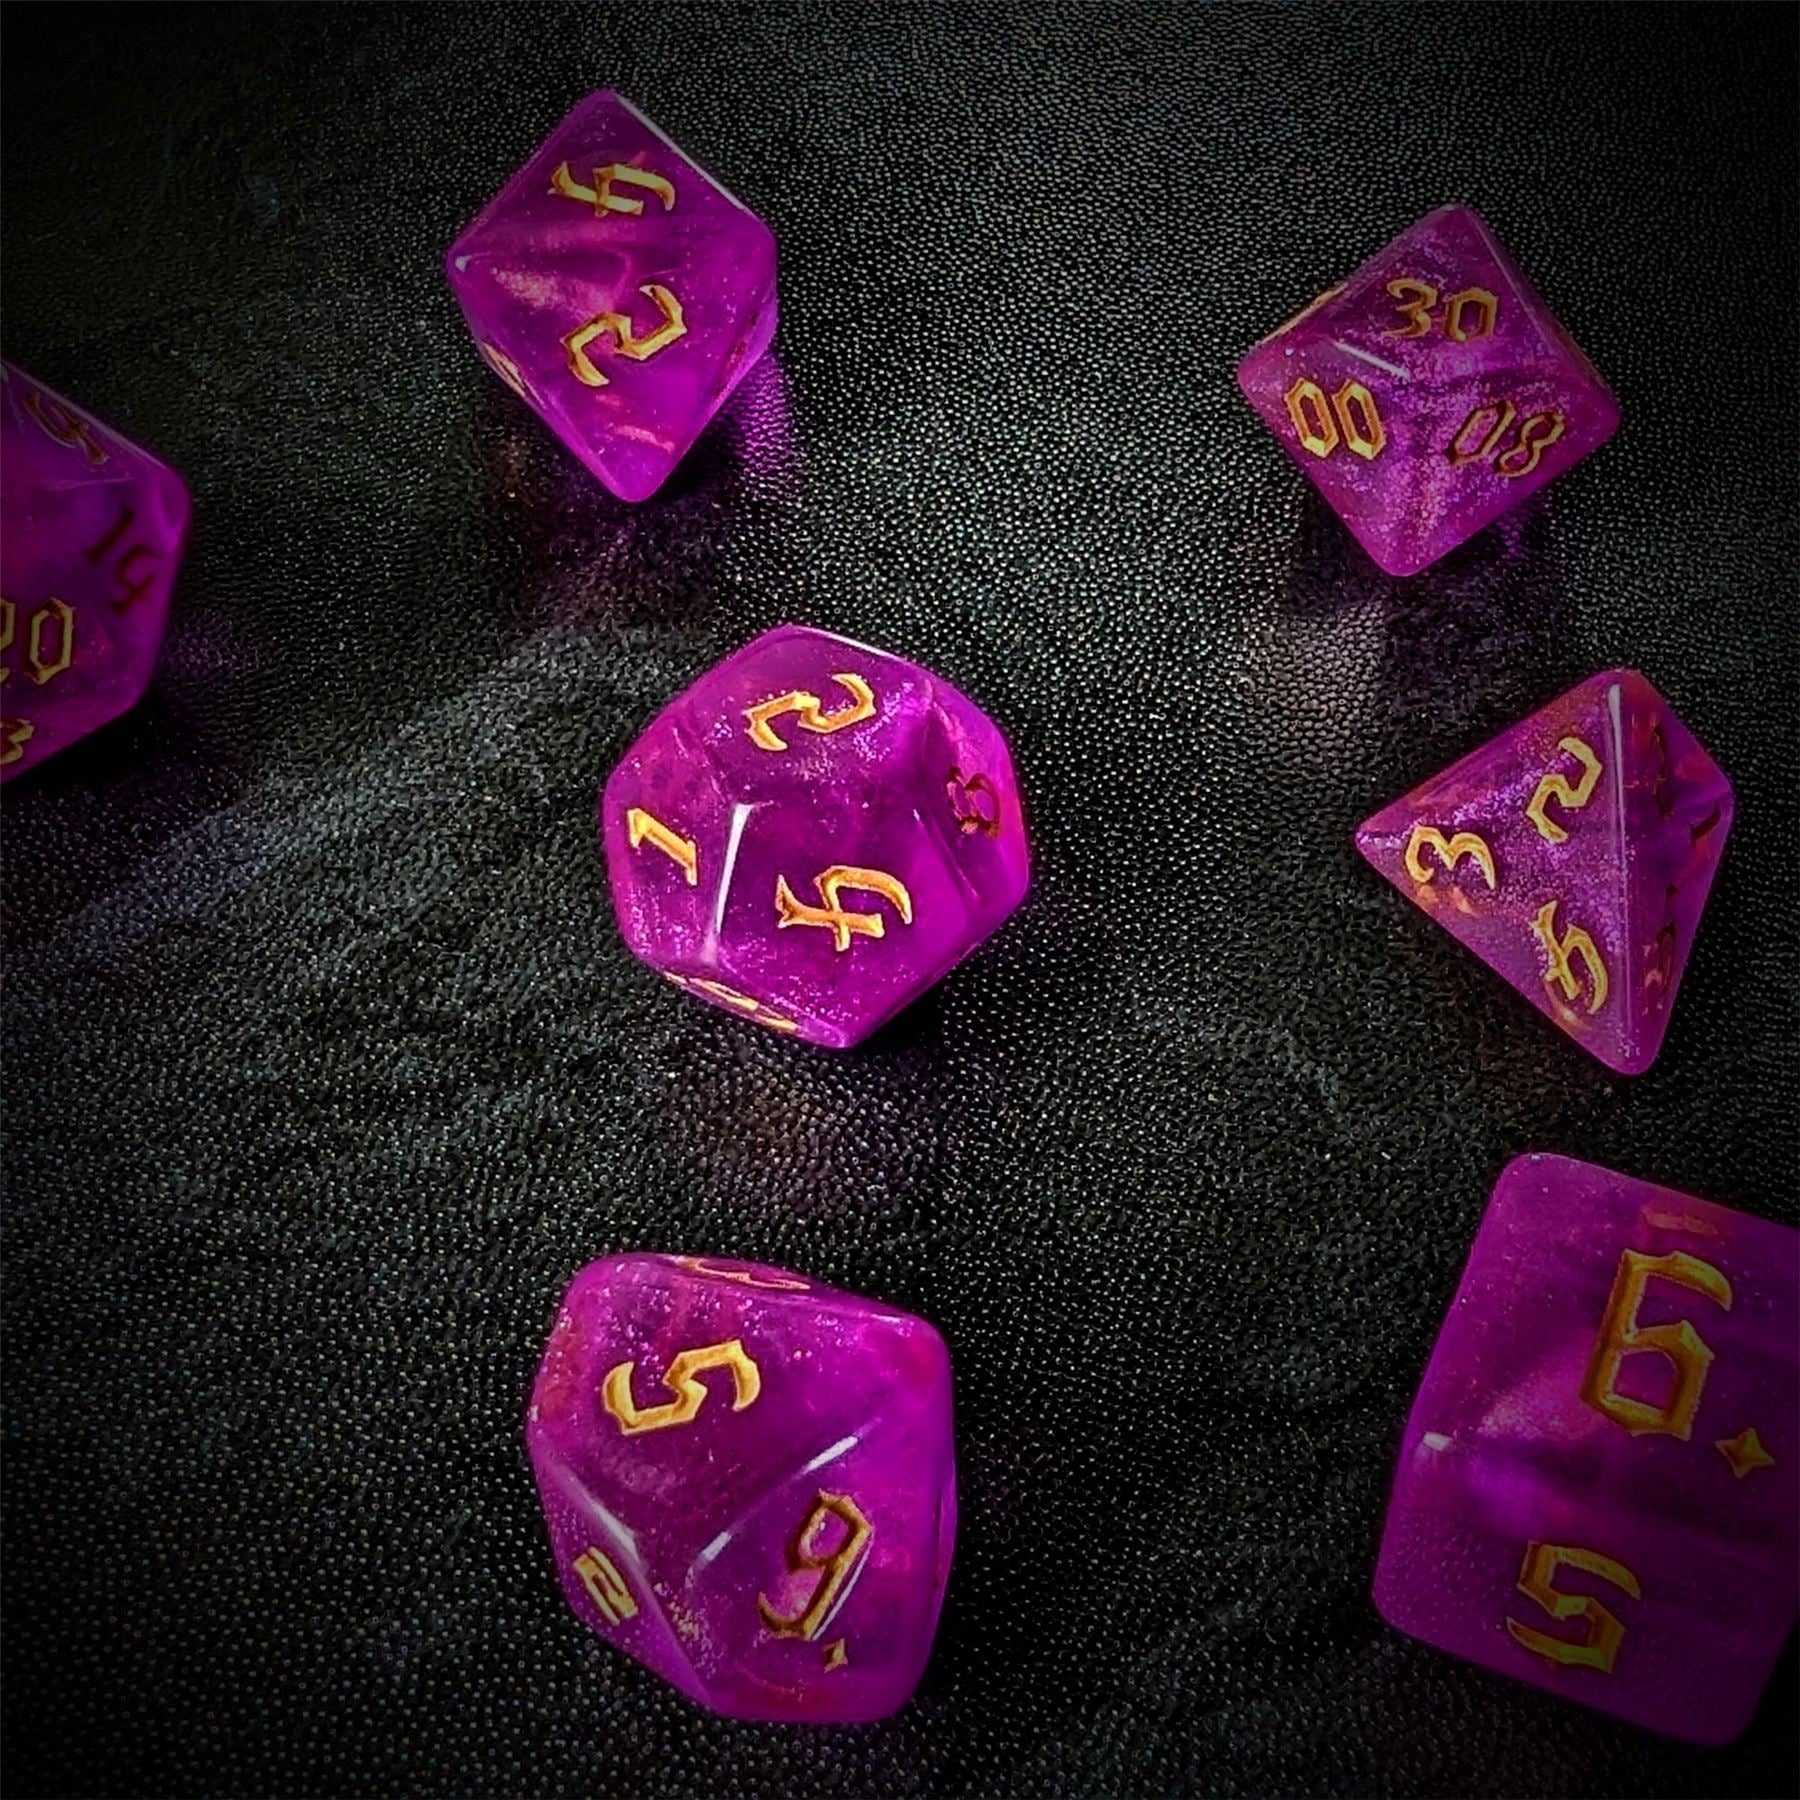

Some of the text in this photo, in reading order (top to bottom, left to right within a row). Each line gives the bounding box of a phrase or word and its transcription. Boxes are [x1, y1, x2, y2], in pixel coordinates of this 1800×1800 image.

[559, 283, 688, 388] 2
[1381, 276, 1499, 345] 30
[1283, 376, 1387, 461] 00
[743, 672, 878, 752] 2
[1525, 735, 1604, 845] 2
[626, 806, 699, 888] 1
[1404, 824, 1497, 891] 3
[602, 1338, 761, 1436] 5
[1505, 1539, 1642, 1675] 5
